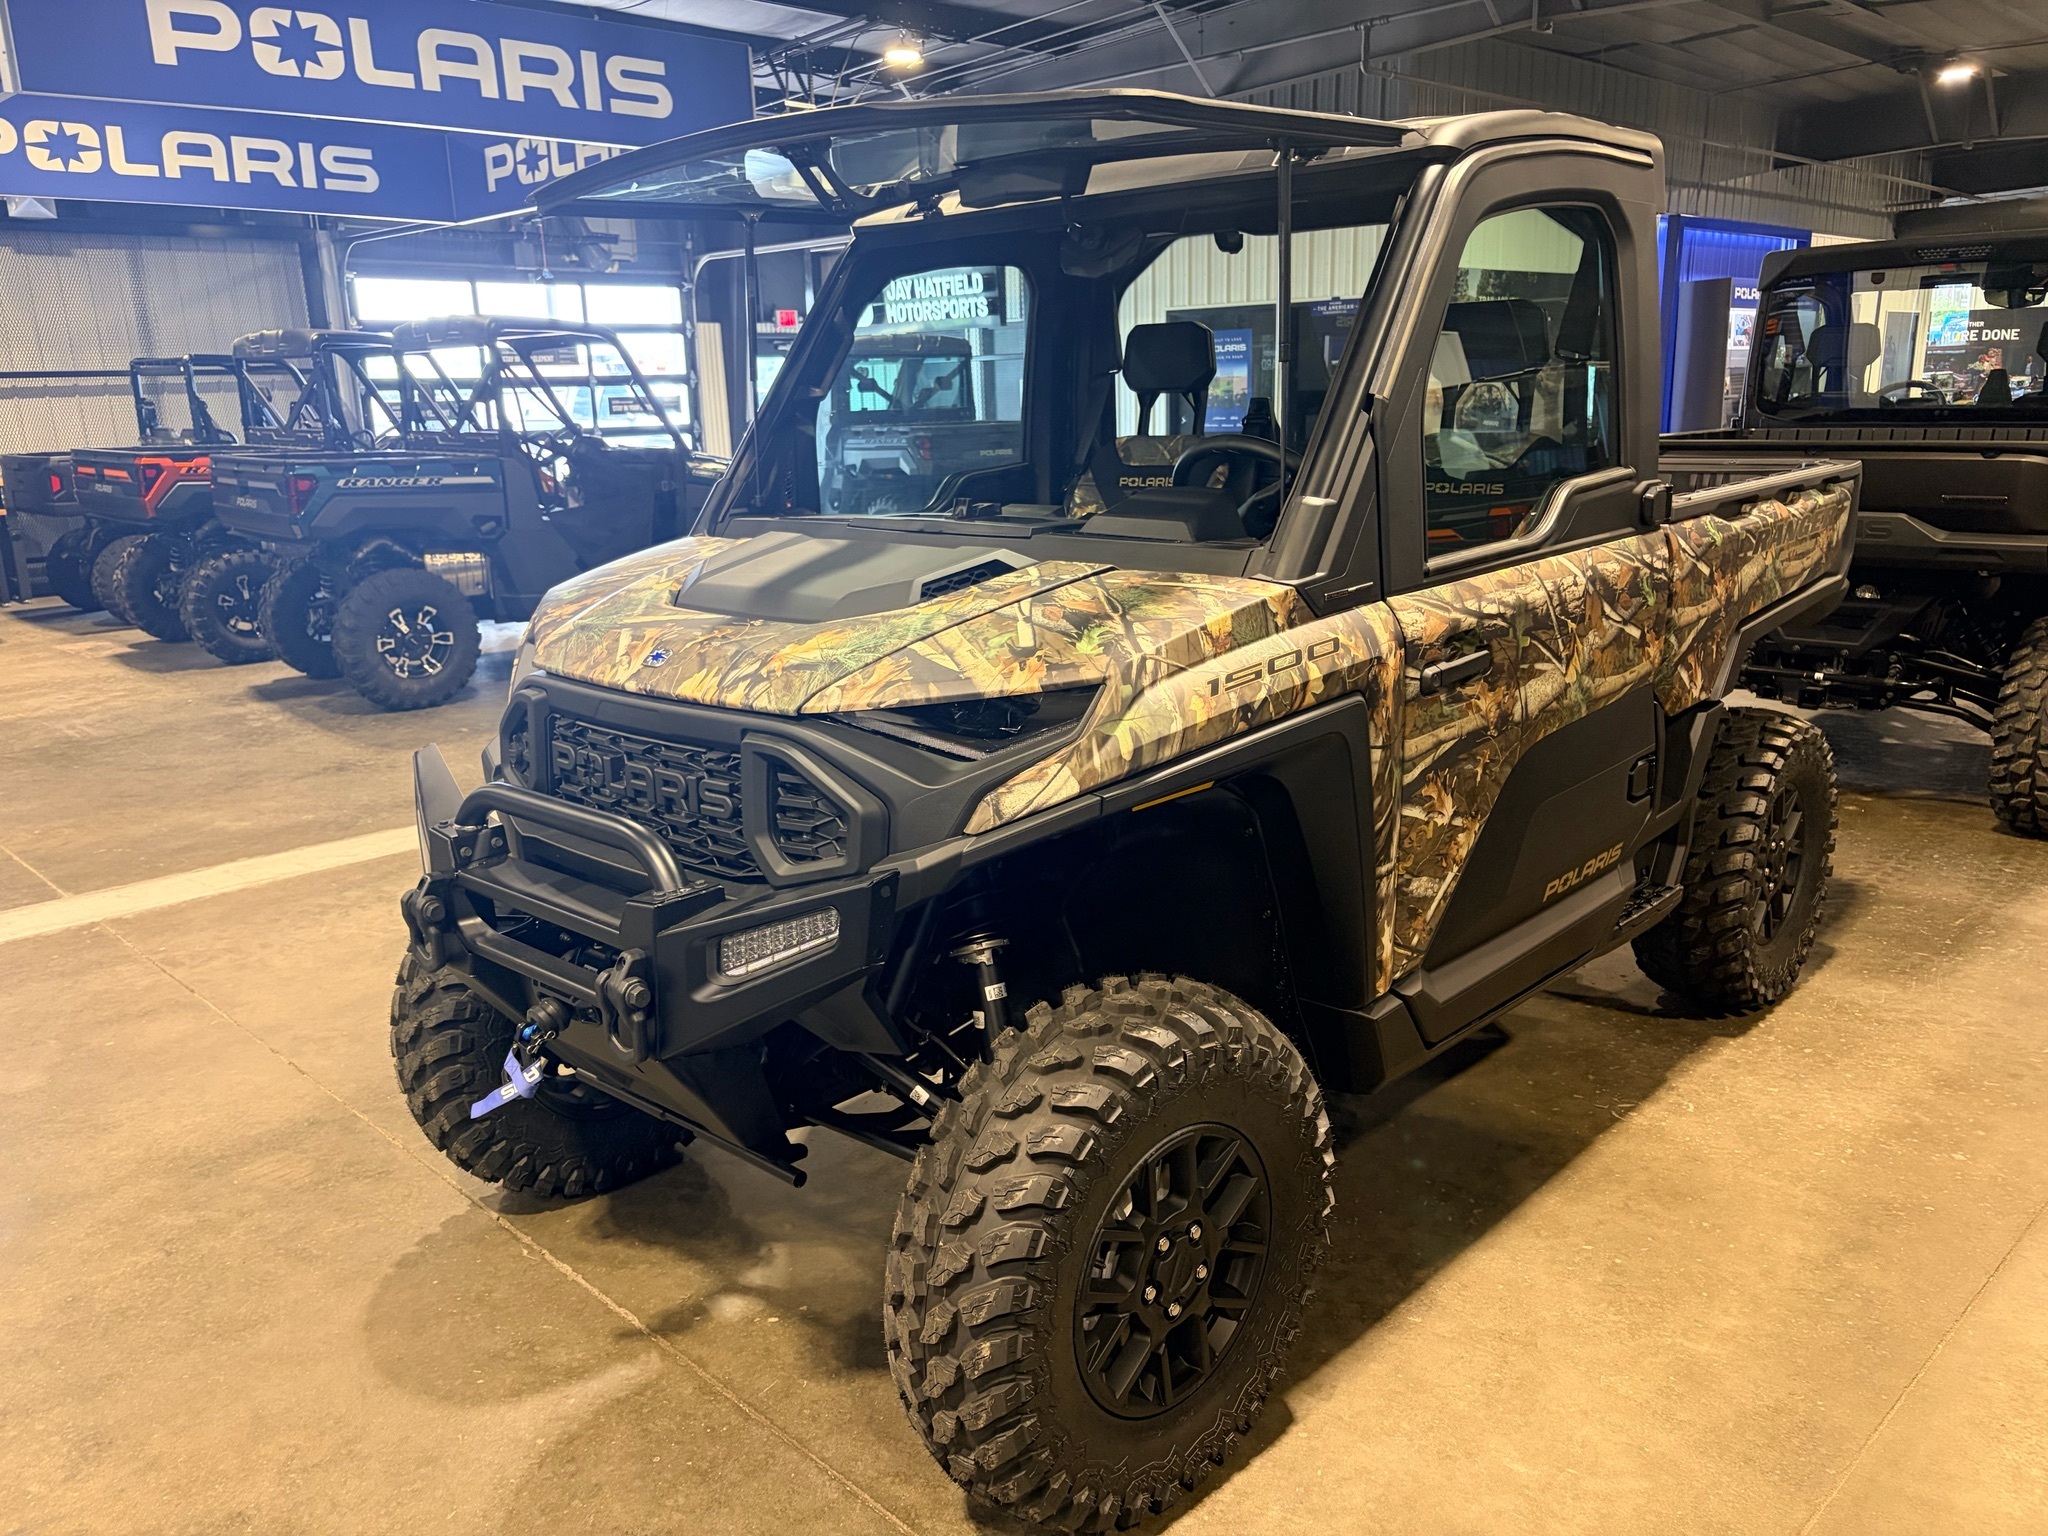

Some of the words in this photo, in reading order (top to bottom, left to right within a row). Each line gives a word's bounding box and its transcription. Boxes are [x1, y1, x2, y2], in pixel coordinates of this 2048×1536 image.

[145, 0, 674, 119] POLARIS
[0, 117, 380, 194] OLARIS
[886, 279, 913, 301] JAY
[914, 272, 984, 299] HATFIELD
[886, 296, 989, 324] MOTORSPORTS
[1215, 343, 1247, 353] OLARIS
[1981, 328, 2021, 341] DONE
[340, 475, 443, 489] RANGER
[552, 739, 735, 819] POLARIS
[1543, 841, 1624, 903] POLARIS
